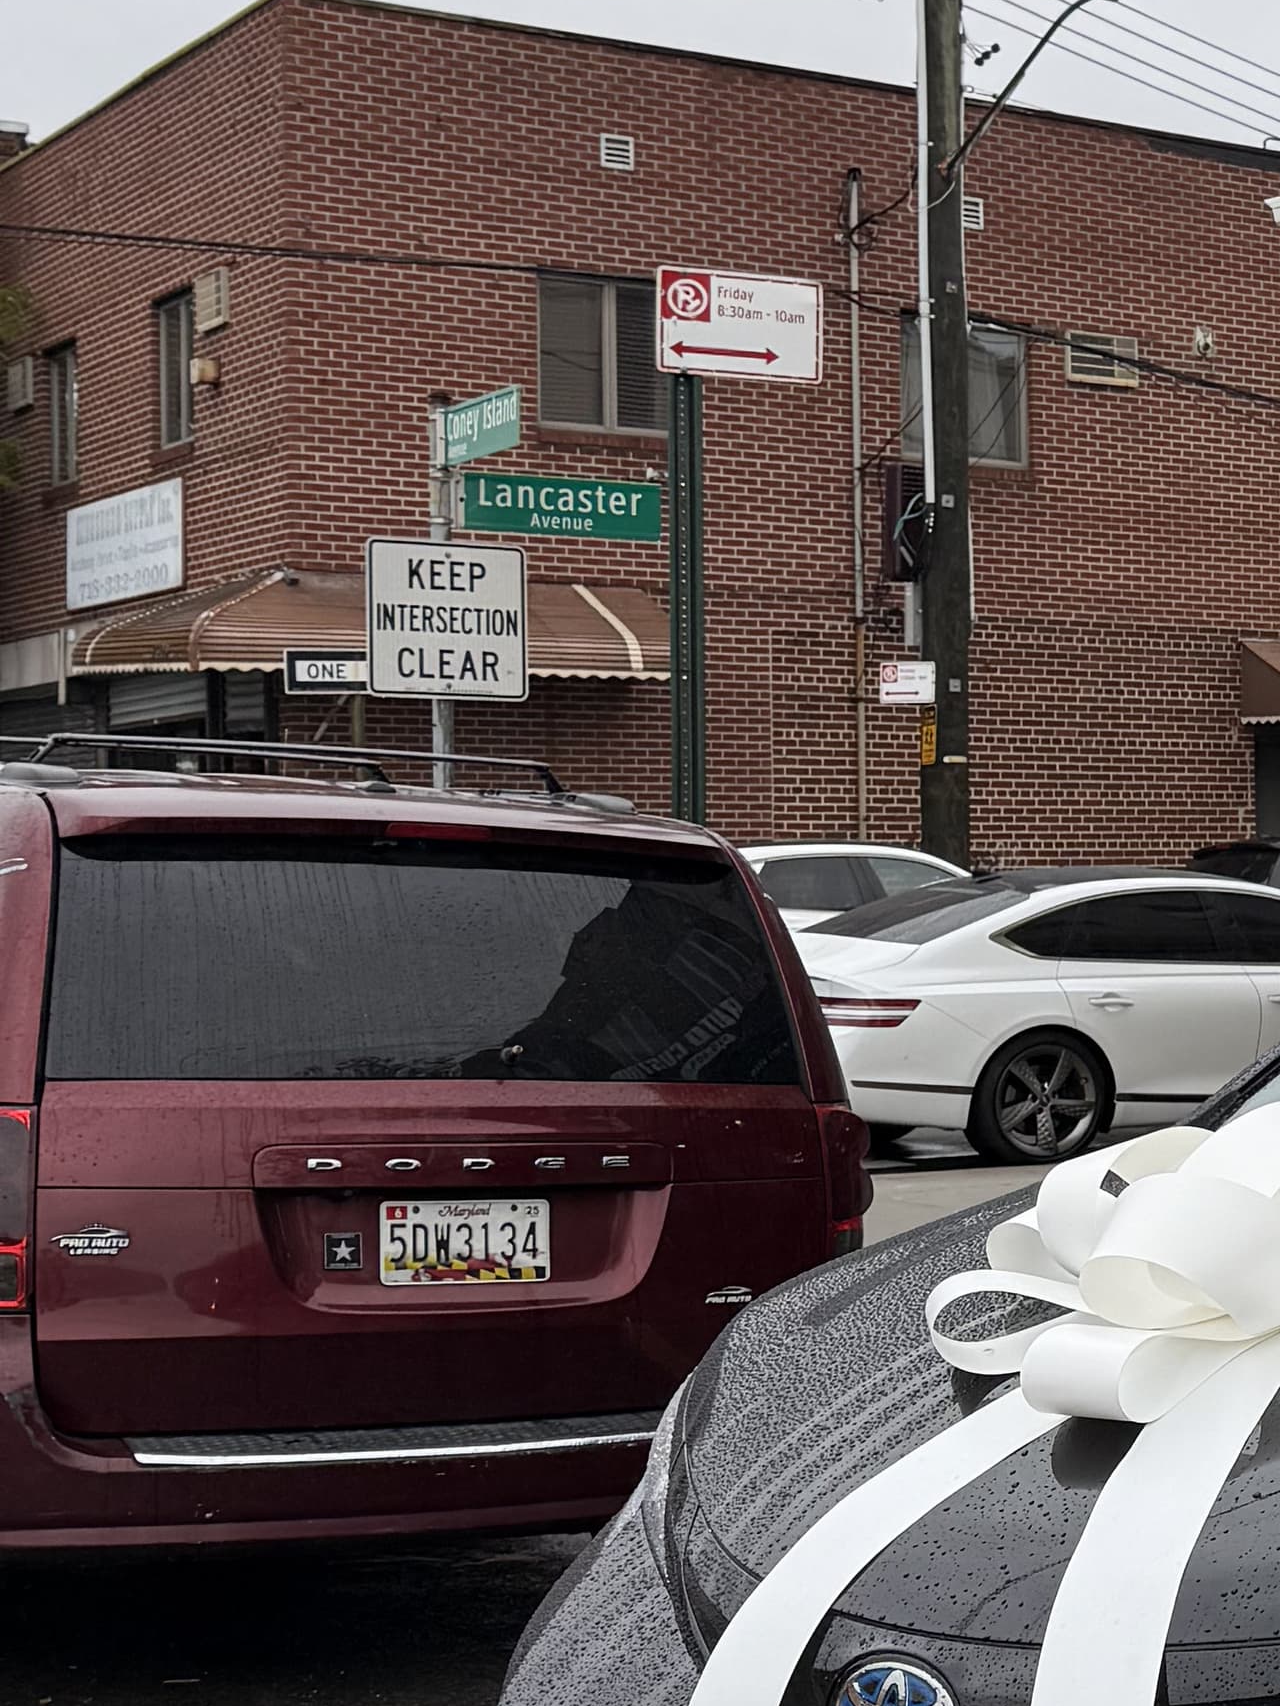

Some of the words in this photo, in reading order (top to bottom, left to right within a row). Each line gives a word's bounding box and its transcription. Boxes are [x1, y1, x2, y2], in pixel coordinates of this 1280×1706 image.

[717, 286, 754, 303] Friday
[717, 305, 763, 320] 8:30am
[775, 310, 805, 324] 10am
[447, 408, 479, 441] Coney
[483, 394, 517, 429] Island
[479, 478, 643, 516] Lancaster
[530, 513, 593, 531] Avenue
[408, 559, 486, 592] KEEP
[376, 603, 518, 637] INTERSECTION
[307, 664, 347, 679] ONE
[398, 648, 499, 682] CLEAR
[307, 1156, 630, 1170] DODGE
[394, 1207, 403, 1218] 6
[438, 1203, 492, 1219] Maryland
[526, 1205, 540, 1215] 25
[60, 1238, 91, 1249] PRO
[92, 1237, 129, 1248] AUTO
[390, 1222, 539, 1264] 5DW3134
